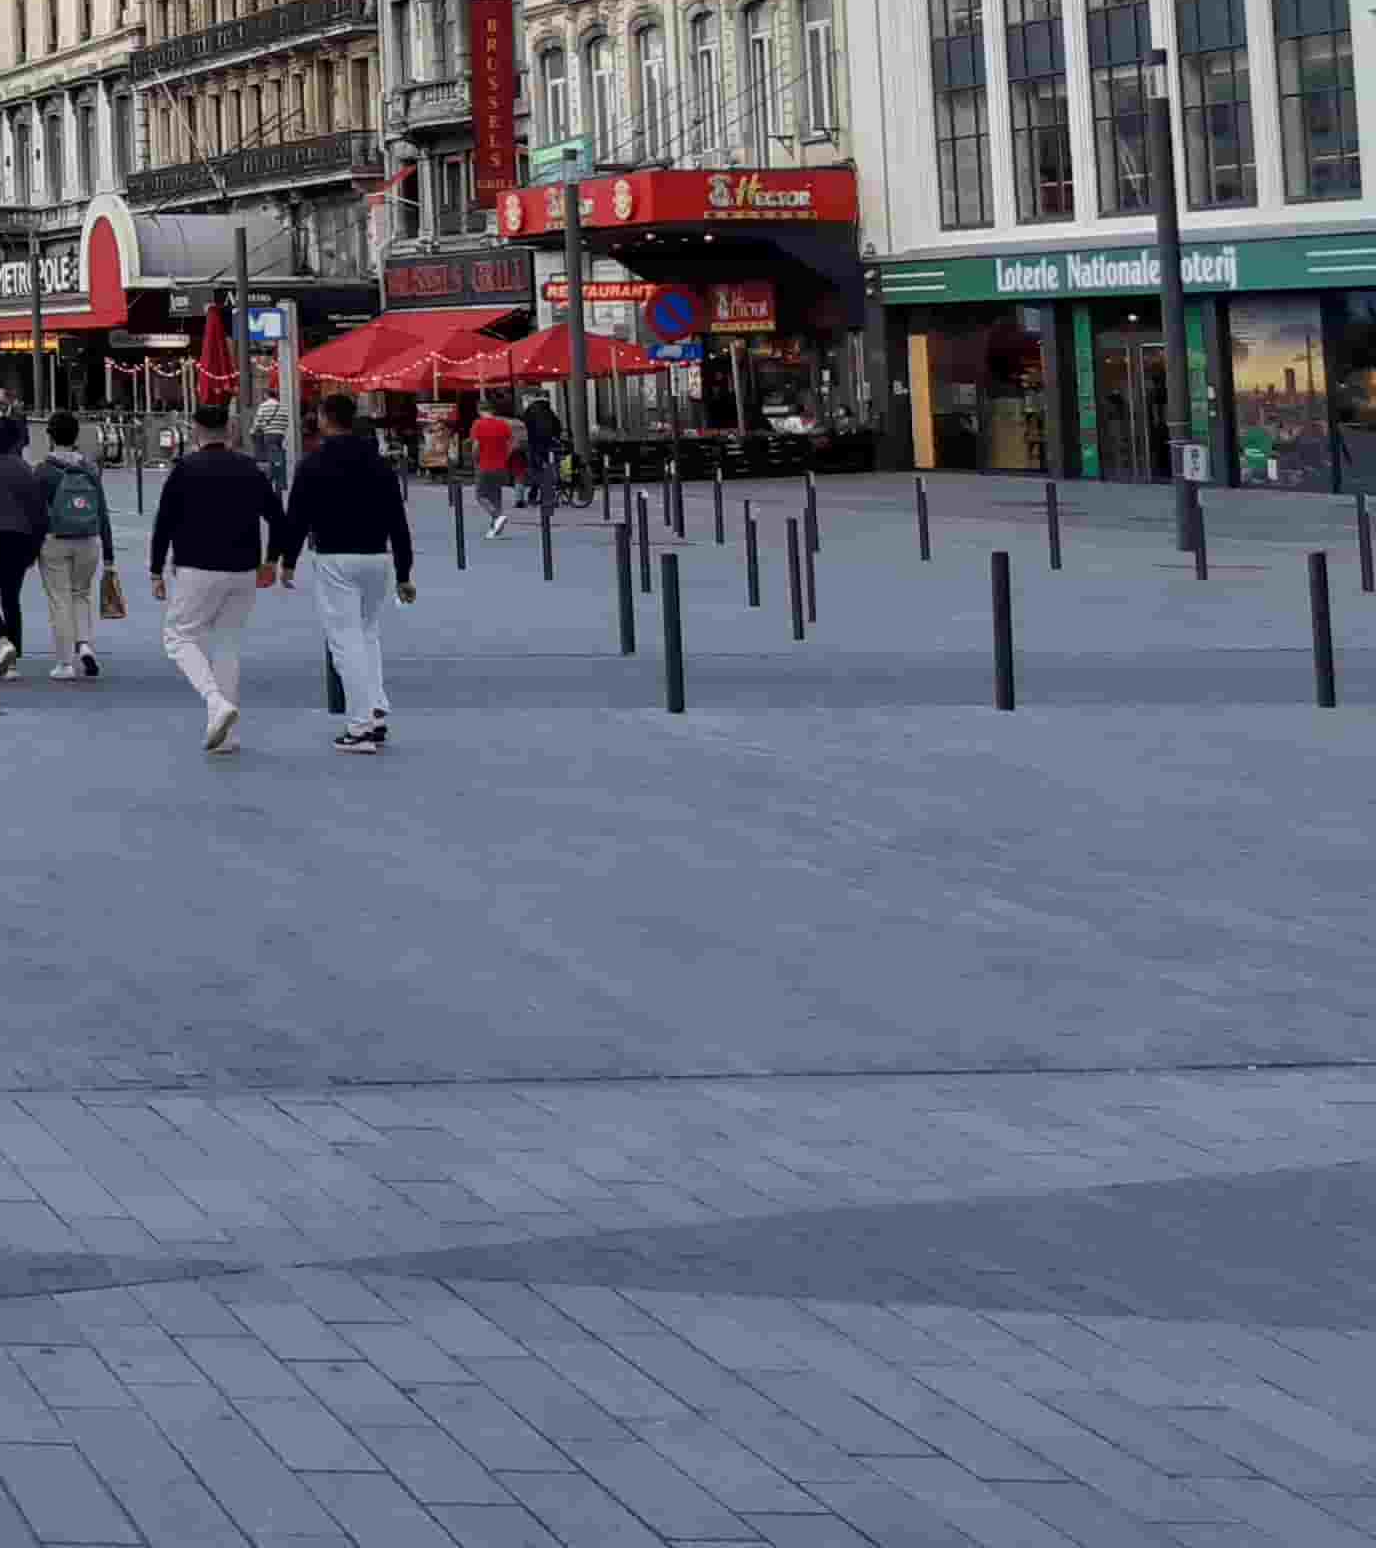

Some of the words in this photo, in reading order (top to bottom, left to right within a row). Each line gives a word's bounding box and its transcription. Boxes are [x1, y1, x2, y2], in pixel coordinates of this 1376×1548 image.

[995, 257, 1059, 292] Loterie
[1065, 249, 1161, 290] Nationale
[1179, 245, 1238, 290] oterij
[546, 283, 655, 301] RETAURANT
